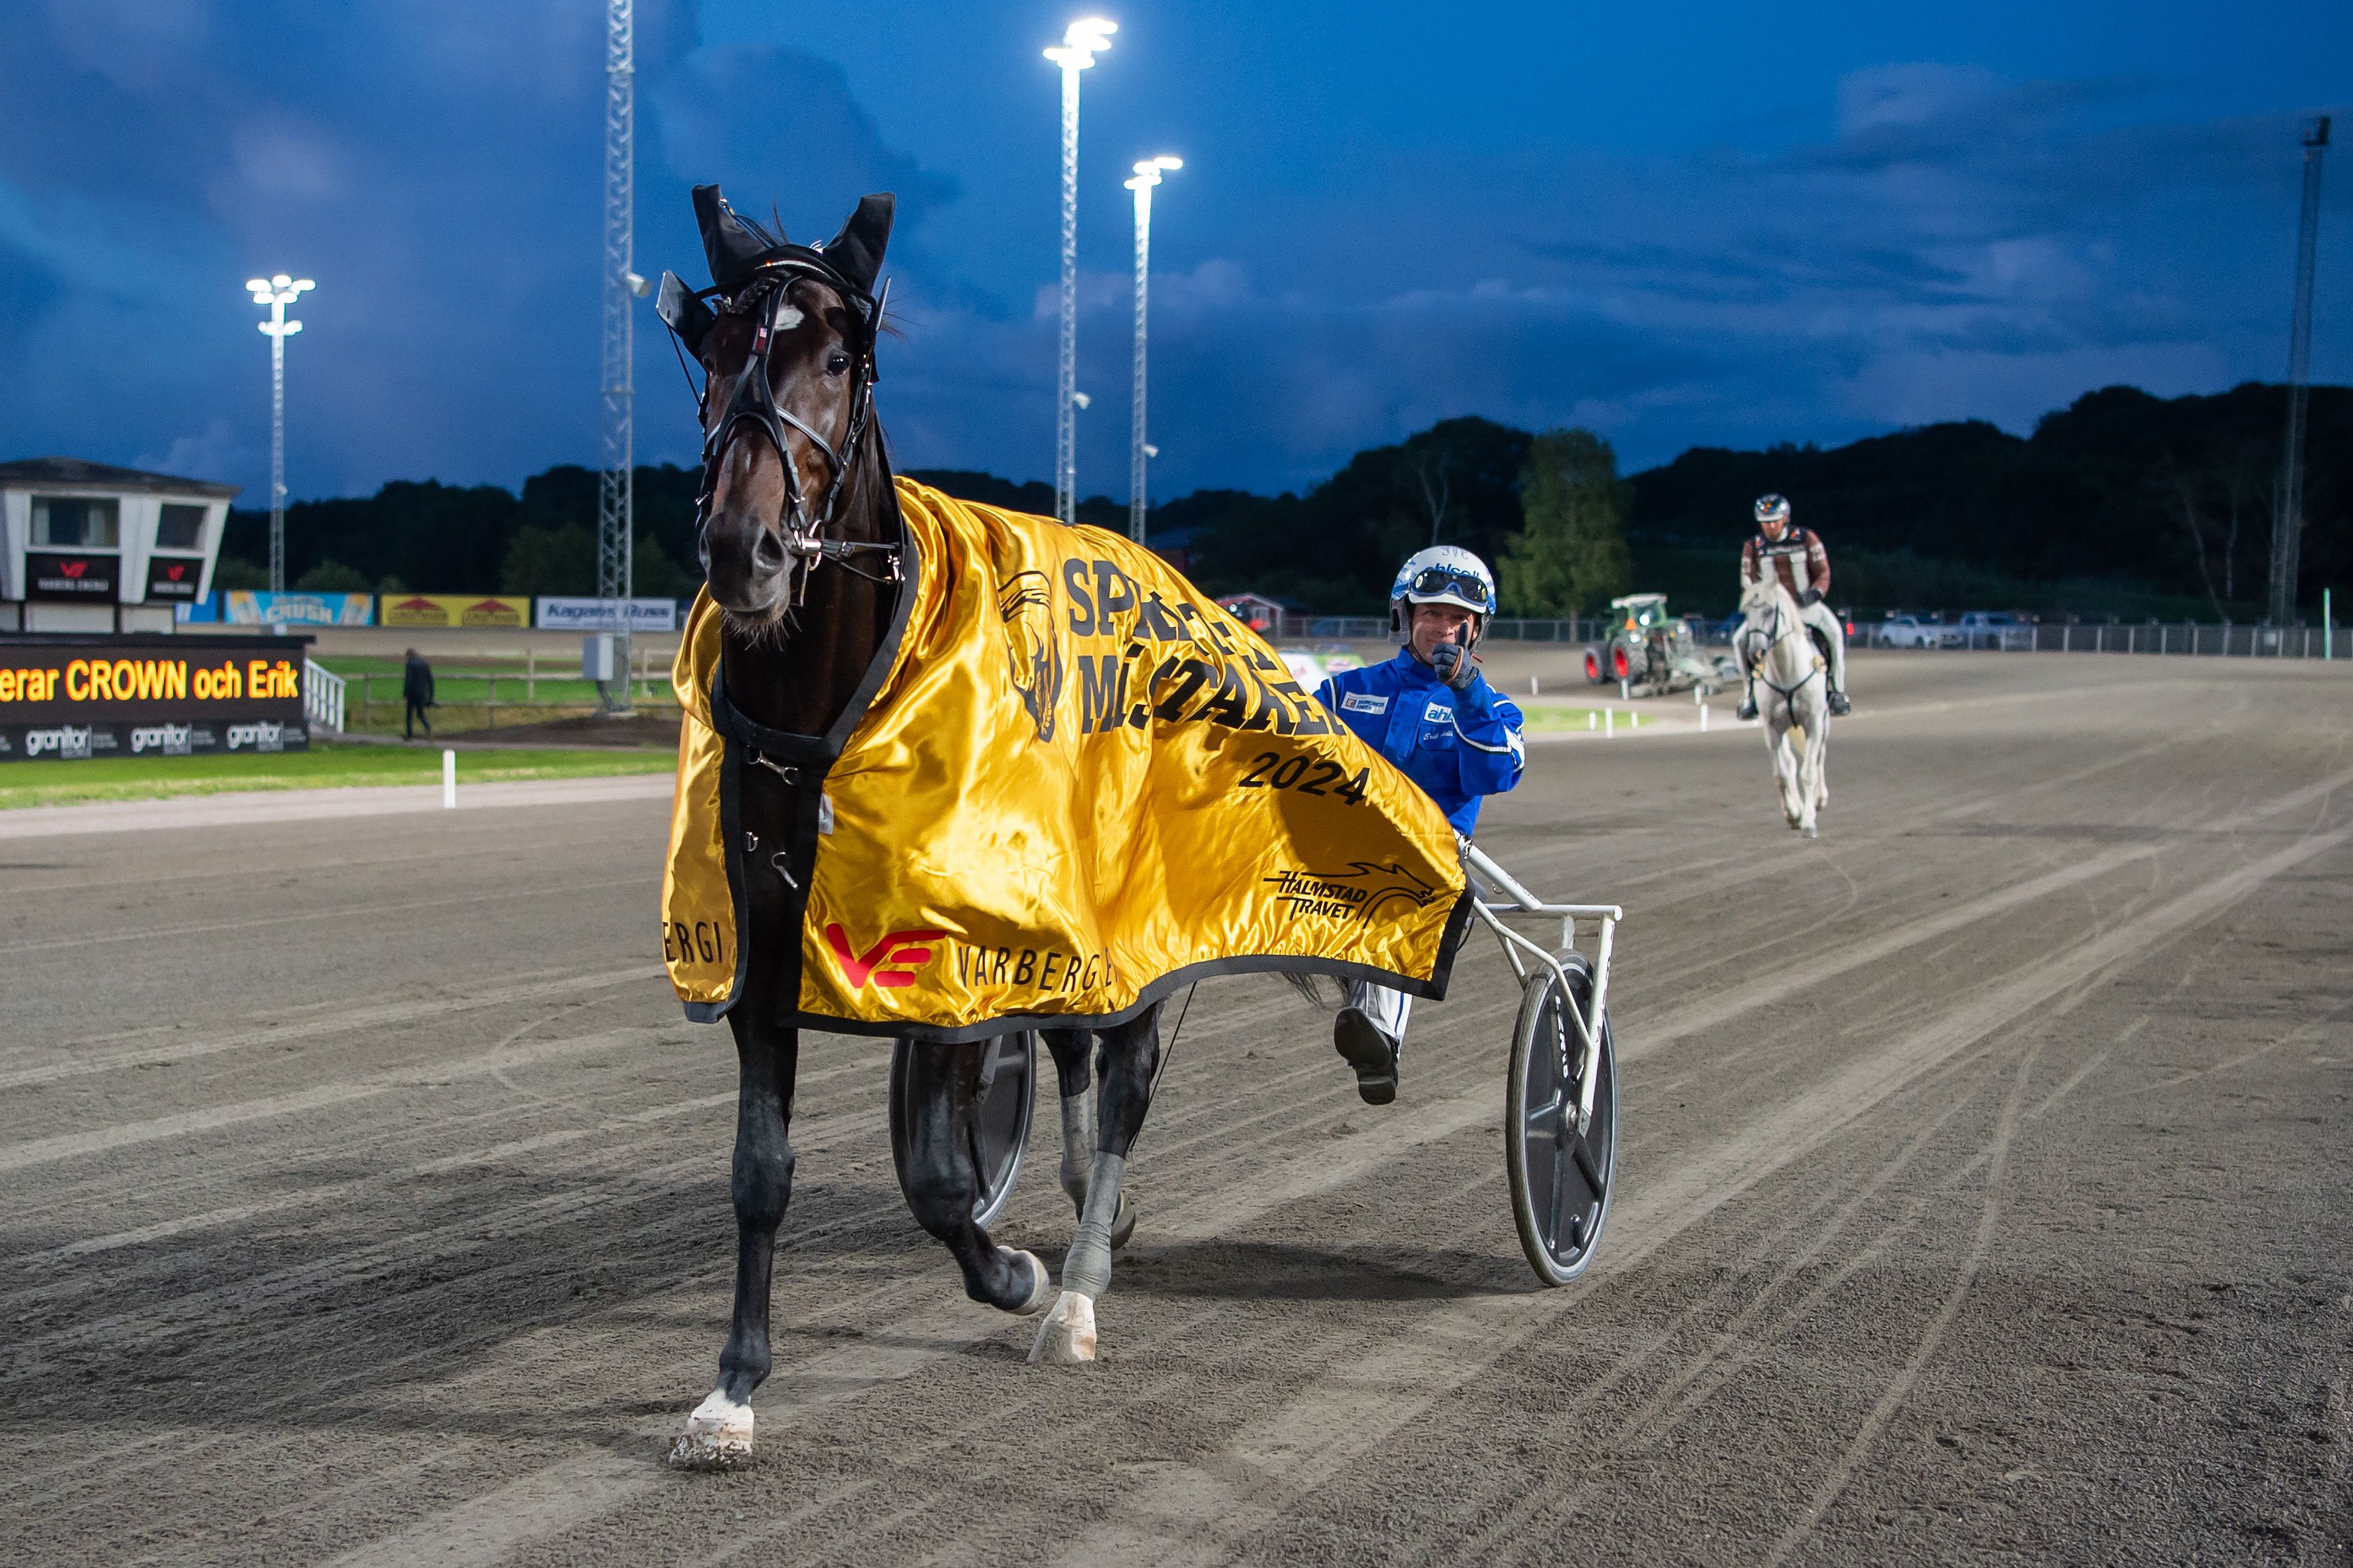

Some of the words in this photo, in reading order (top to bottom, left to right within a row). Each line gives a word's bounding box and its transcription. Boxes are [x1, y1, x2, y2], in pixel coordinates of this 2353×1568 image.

[0, 668, 60, 702] erar
[66, 658, 187, 701] CROWN
[193, 660, 242, 700] och
[248, 660, 298, 699] Erik
[1238, 751, 1370, 806] 2024
[1263, 870, 1368, 902] HALMSTAD
[1277, 896, 1354, 921] TRAVET
[958, 945, 1100, 993] VARBERG
